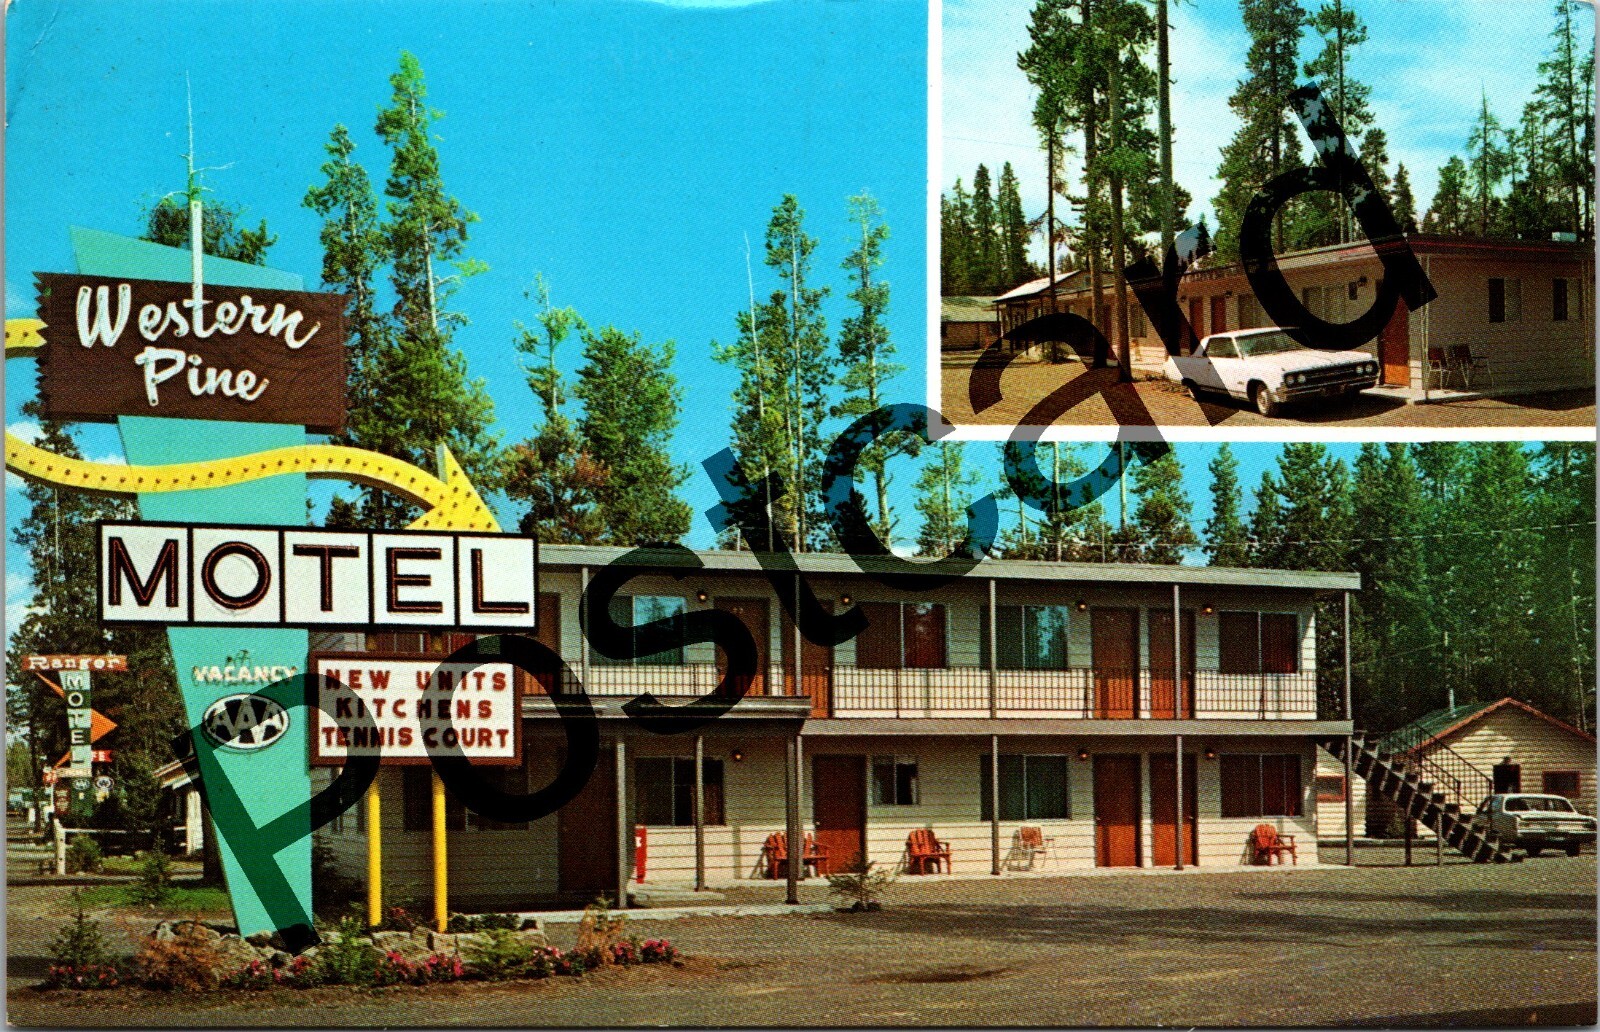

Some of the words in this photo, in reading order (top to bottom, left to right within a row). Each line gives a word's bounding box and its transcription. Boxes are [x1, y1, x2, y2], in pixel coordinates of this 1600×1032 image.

[75, 283, 321, 349] Western
[134, 346, 270, 407] Pine
[107, 535, 531, 615] MOTEL
[28, 656, 121, 670] Ranger
[192, 665, 297, 684] VACANCY
[325, 668, 391, 690] NEW
[416, 670, 507, 692] UNITS
[66, 674, 85, 764] MOTEL
[208, 698, 285, 744] AAA
[336, 697, 493, 719] KITCHENS
[321, 726, 414, 748] TENNIS
[422, 727, 510, 749] COURT
